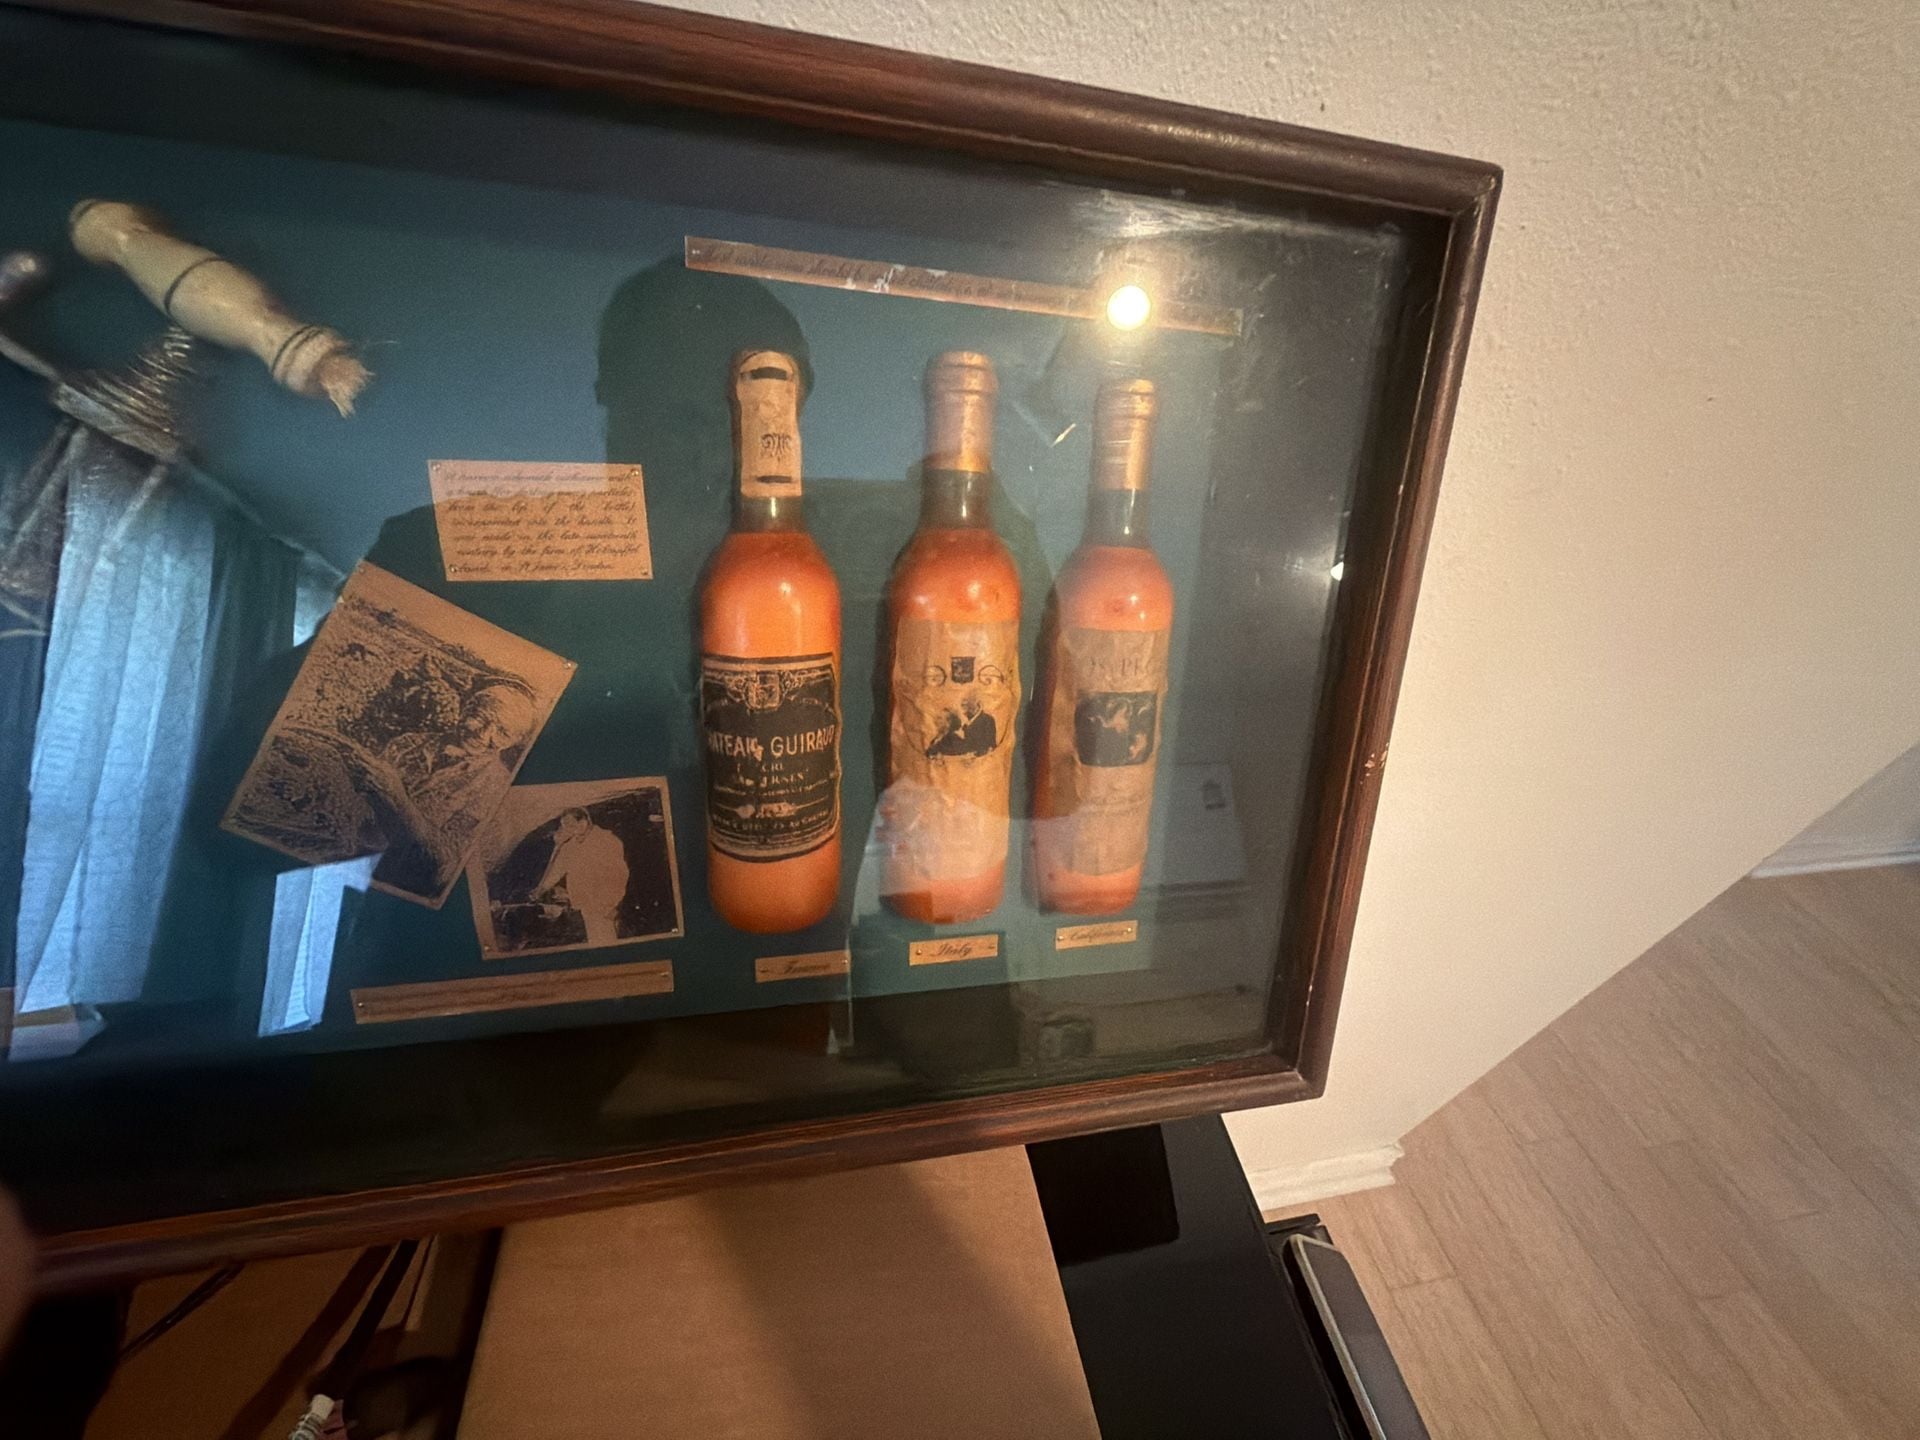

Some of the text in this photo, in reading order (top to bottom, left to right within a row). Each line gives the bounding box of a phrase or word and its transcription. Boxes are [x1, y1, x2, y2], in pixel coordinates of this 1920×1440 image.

[569, 500, 585, 512] the
[554, 515, 571, 526] the
[536, 530, 553, 541] the
[502, 545, 516, 558] by
[520, 545, 537, 556] the
[930, 943, 972, 958] Italy
